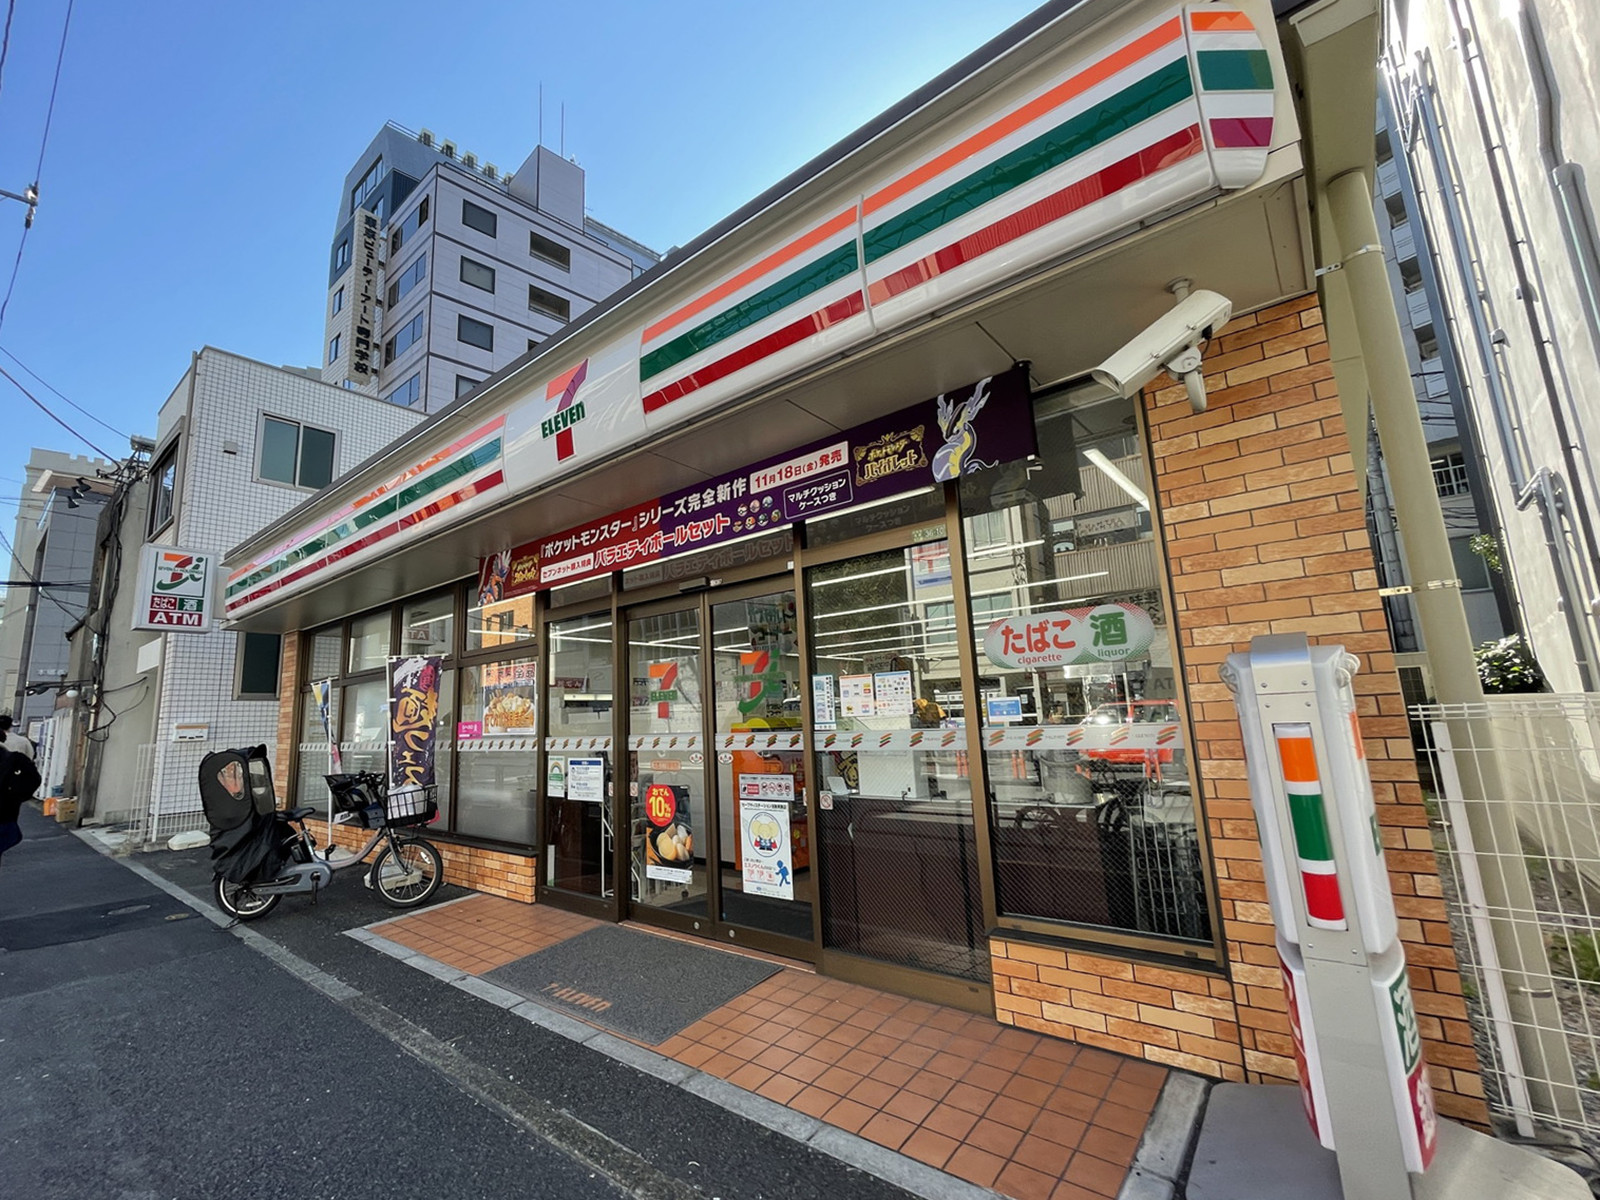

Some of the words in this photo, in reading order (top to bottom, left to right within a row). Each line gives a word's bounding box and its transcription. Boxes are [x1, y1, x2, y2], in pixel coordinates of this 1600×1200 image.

[787, 479, 846, 503] マルチクッション
[798, 492, 837, 510] ケースつき
[595, 513, 731, 569] バラエティボールセット
[152, 597, 175, 609] たばこ
[183, 598, 198, 611] 酒
[153, 612, 199, 625] ATM
[1001, 620, 1076, 655] たばこ
[1089, 612, 1128, 647] 酒
[1017, 653, 1062, 665] cigarette
[1098, 647, 1130, 658] liquor
[652, 788, 670, 796] おでん
